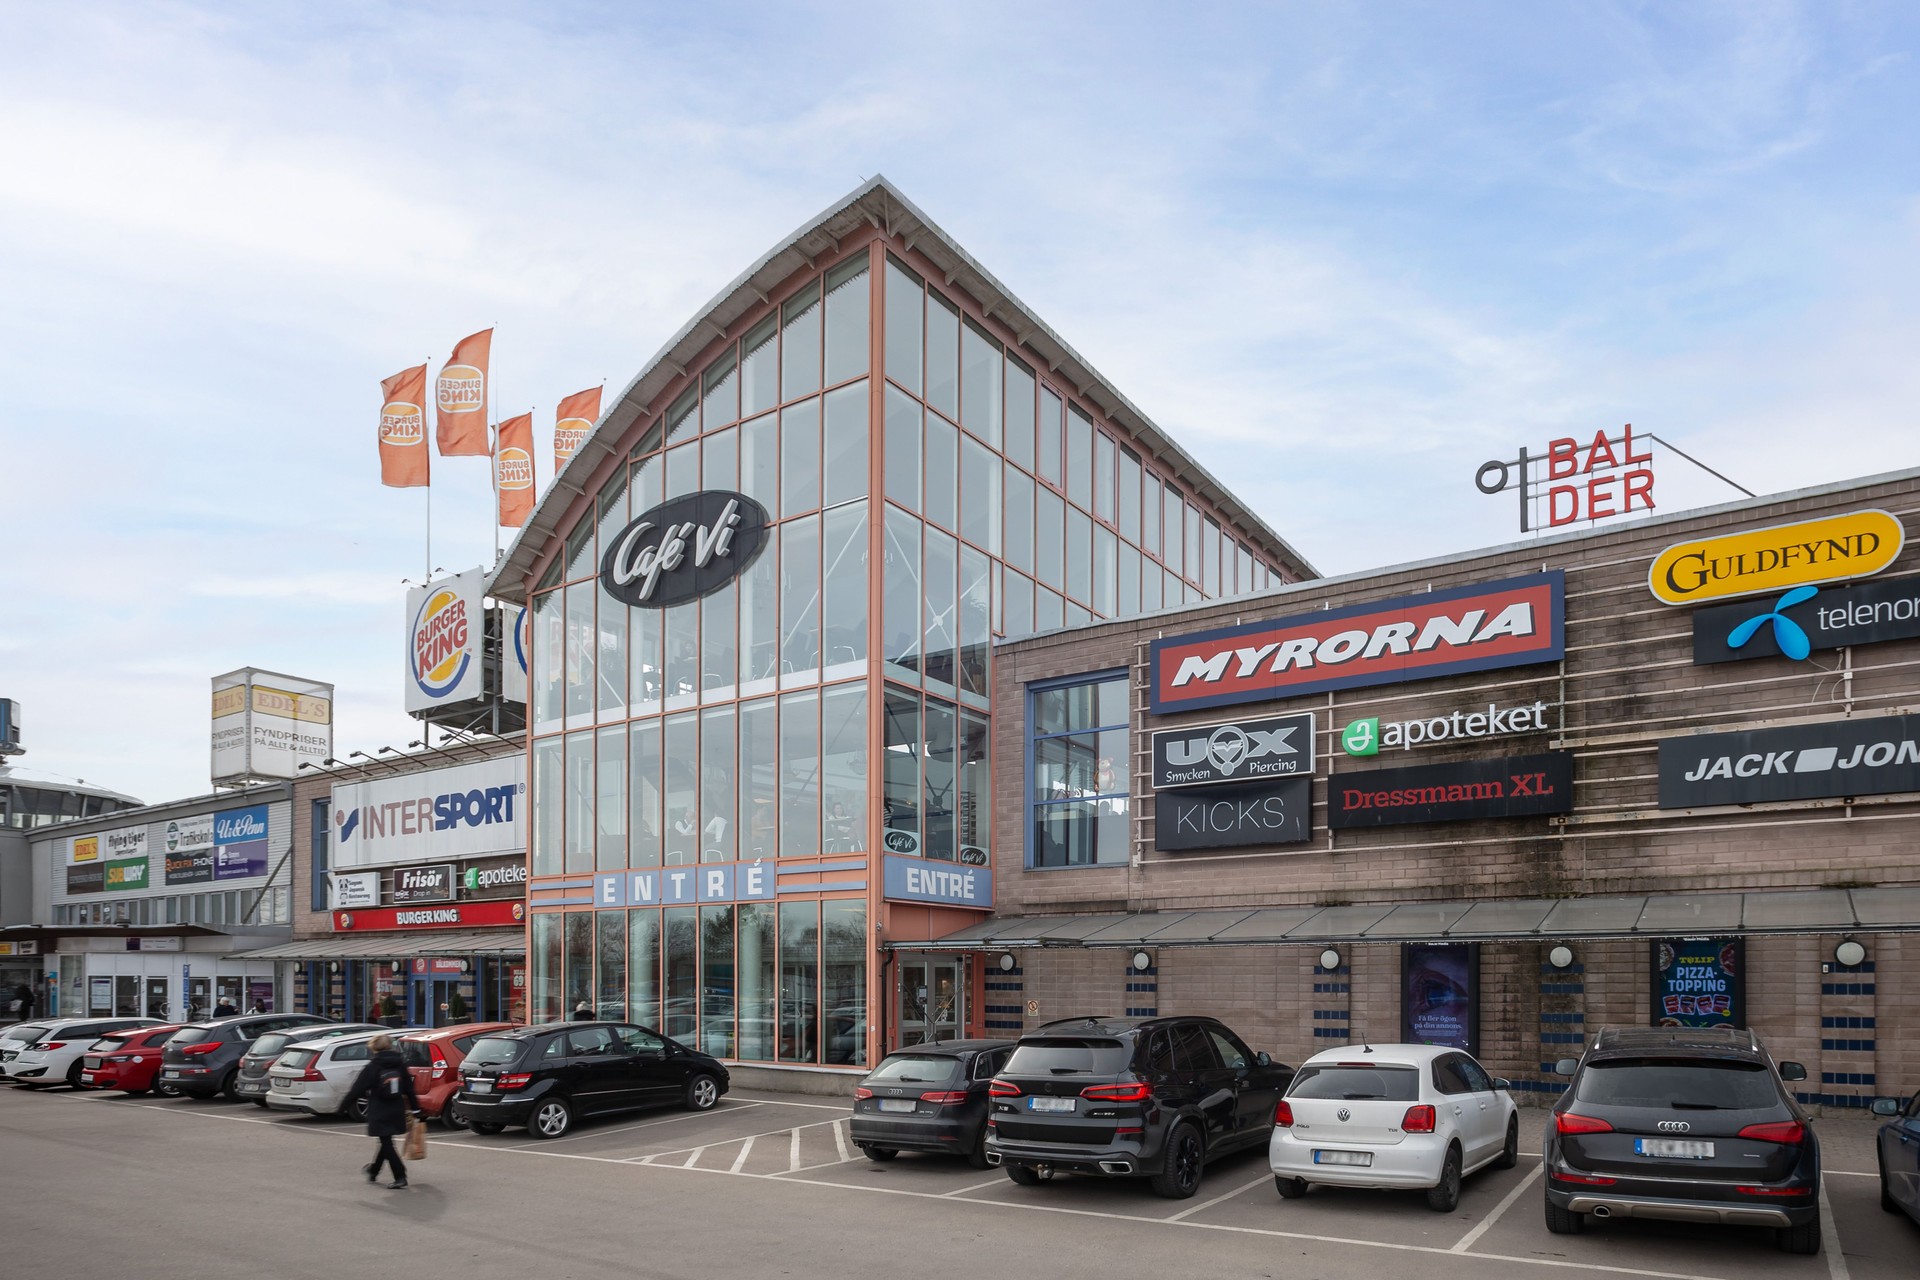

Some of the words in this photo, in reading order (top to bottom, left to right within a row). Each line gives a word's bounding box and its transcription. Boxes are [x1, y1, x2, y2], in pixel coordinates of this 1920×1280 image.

[1548, 423, 1653, 480] BAL
[1549, 469, 1656, 527] DER
[612, 521, 696, 600] Café
[695, 498, 742, 568] Vi
[1665, 531, 1880, 594] GULDFYND
[417, 599, 466, 653] BURGER
[418, 618, 467, 681] KING
[1171, 601, 1534, 687] MYRORNA
[254, 726, 327, 746] FYNDPRISER
[1384, 701, 1548, 750] apoteket
[268, 740, 288, 750] ALLT
[289, 743, 297, 751] &
[298, 745, 327, 756] ALLTID
[1166, 768, 1211, 783] Smycken
[1249, 758, 1297, 774] Piercing
[1684, 749, 1794, 782] JACK
[1342, 779, 1504, 811] Dressmann
[1510, 772, 1554, 798] XL
[1177, 796, 1285, 834] KICKS
[108, 834, 128, 850] flying
[127, 831, 145, 847] tiger
[888, 833, 904, 851] Café
[904, 837, 913, 849] Vi
[961, 849, 976, 865] Café
[975, 853, 984, 863] Vi
[107, 864, 146, 884] SUBWAY
[402, 868, 443, 889] Frisör
[602, 857, 763, 903] ENTRÉ
[906, 869, 975, 900] ENTRÉ
[396, 911, 433, 925] BURGER
[433, 908, 459, 923] KING
[1667, 979, 1726, 992] TOPPING
[1414, 1022, 1423, 1030] på
